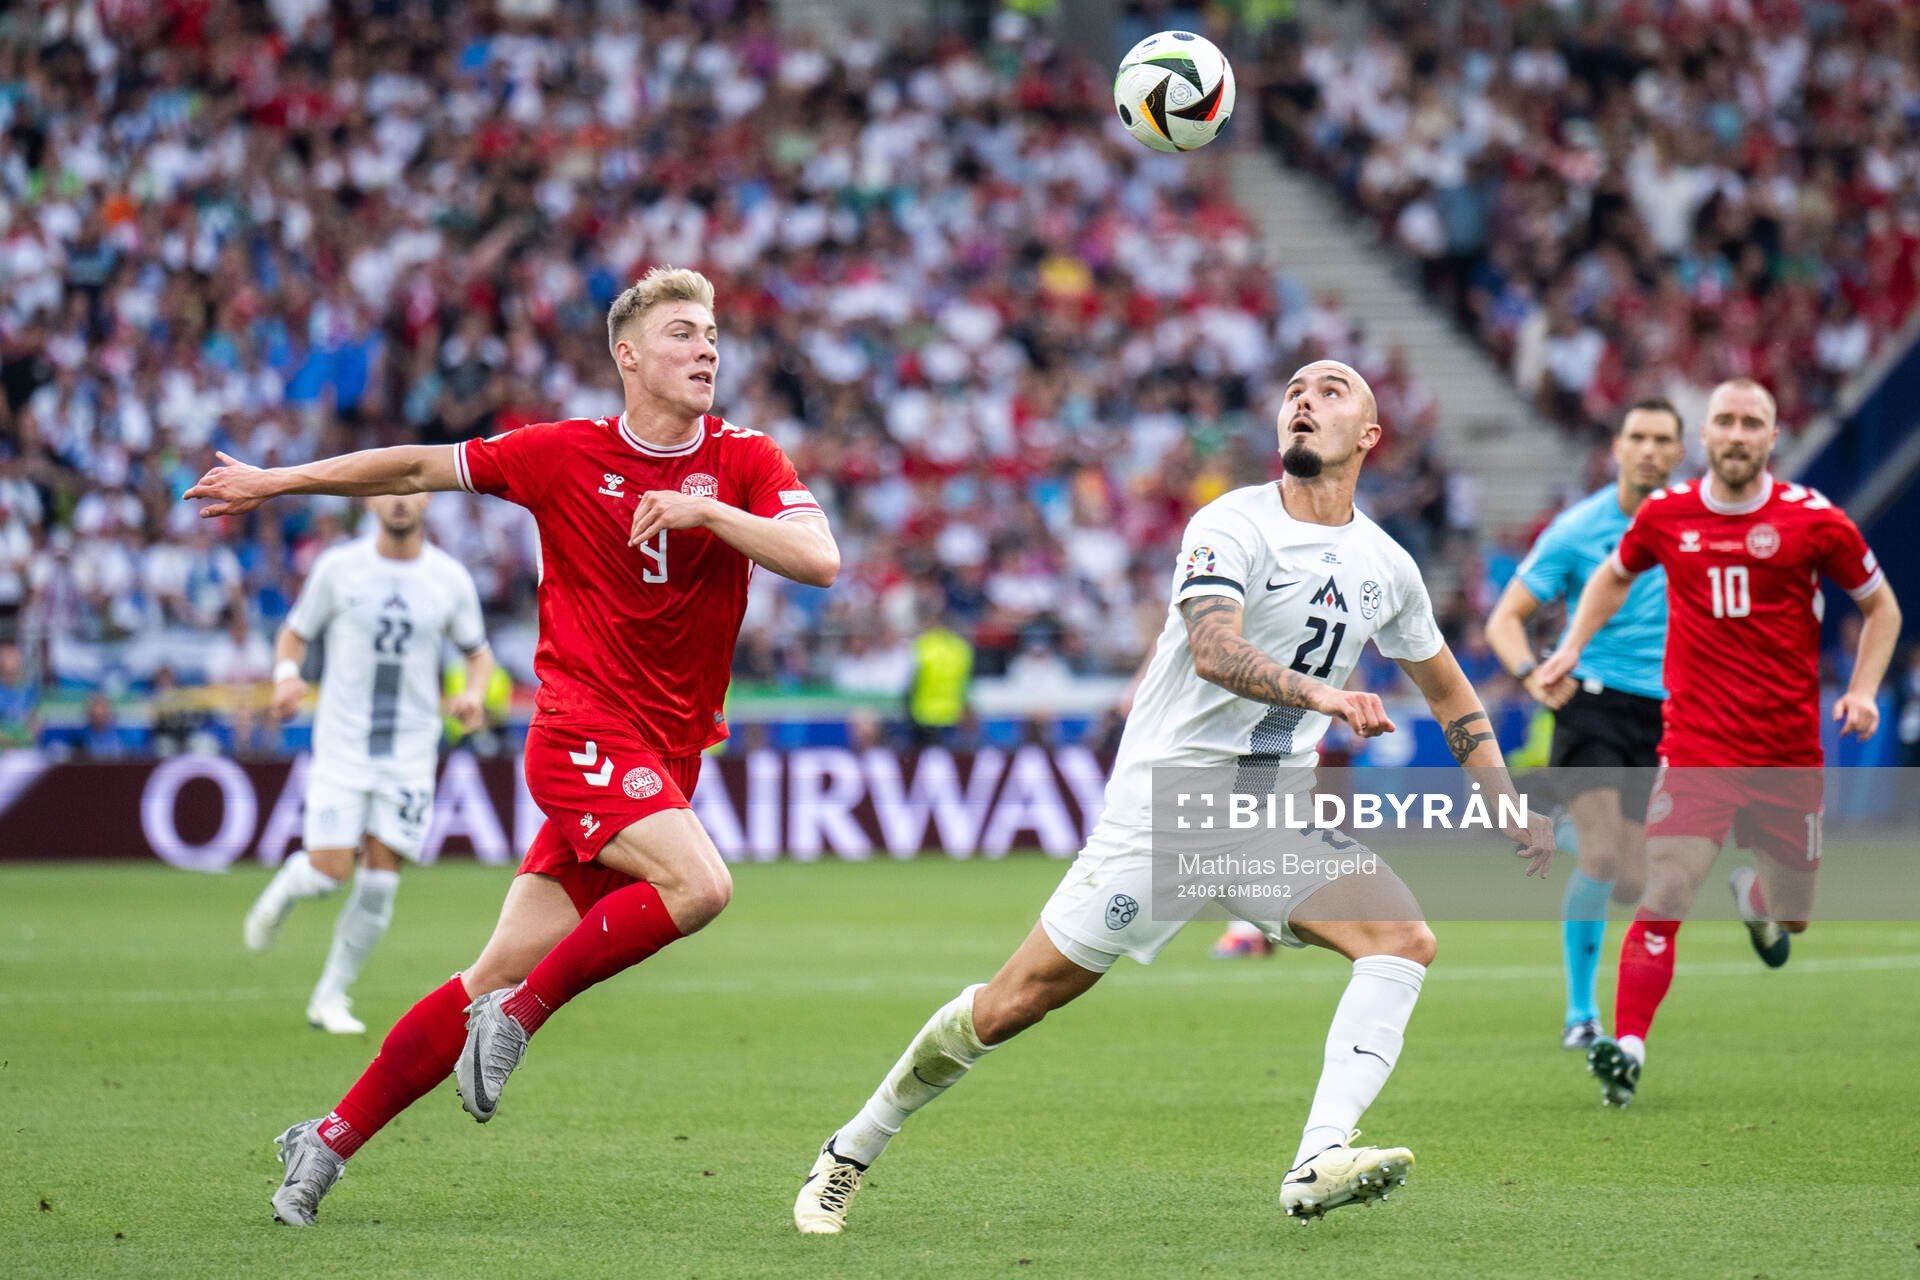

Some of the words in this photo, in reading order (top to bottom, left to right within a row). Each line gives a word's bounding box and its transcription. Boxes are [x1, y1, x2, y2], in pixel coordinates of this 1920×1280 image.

[1707, 565, 1751, 619] 10
[373, 616, 414, 655] 22
[1289, 616, 1347, 679] 21
[690, 744, 1140, 862] AIRWAY
